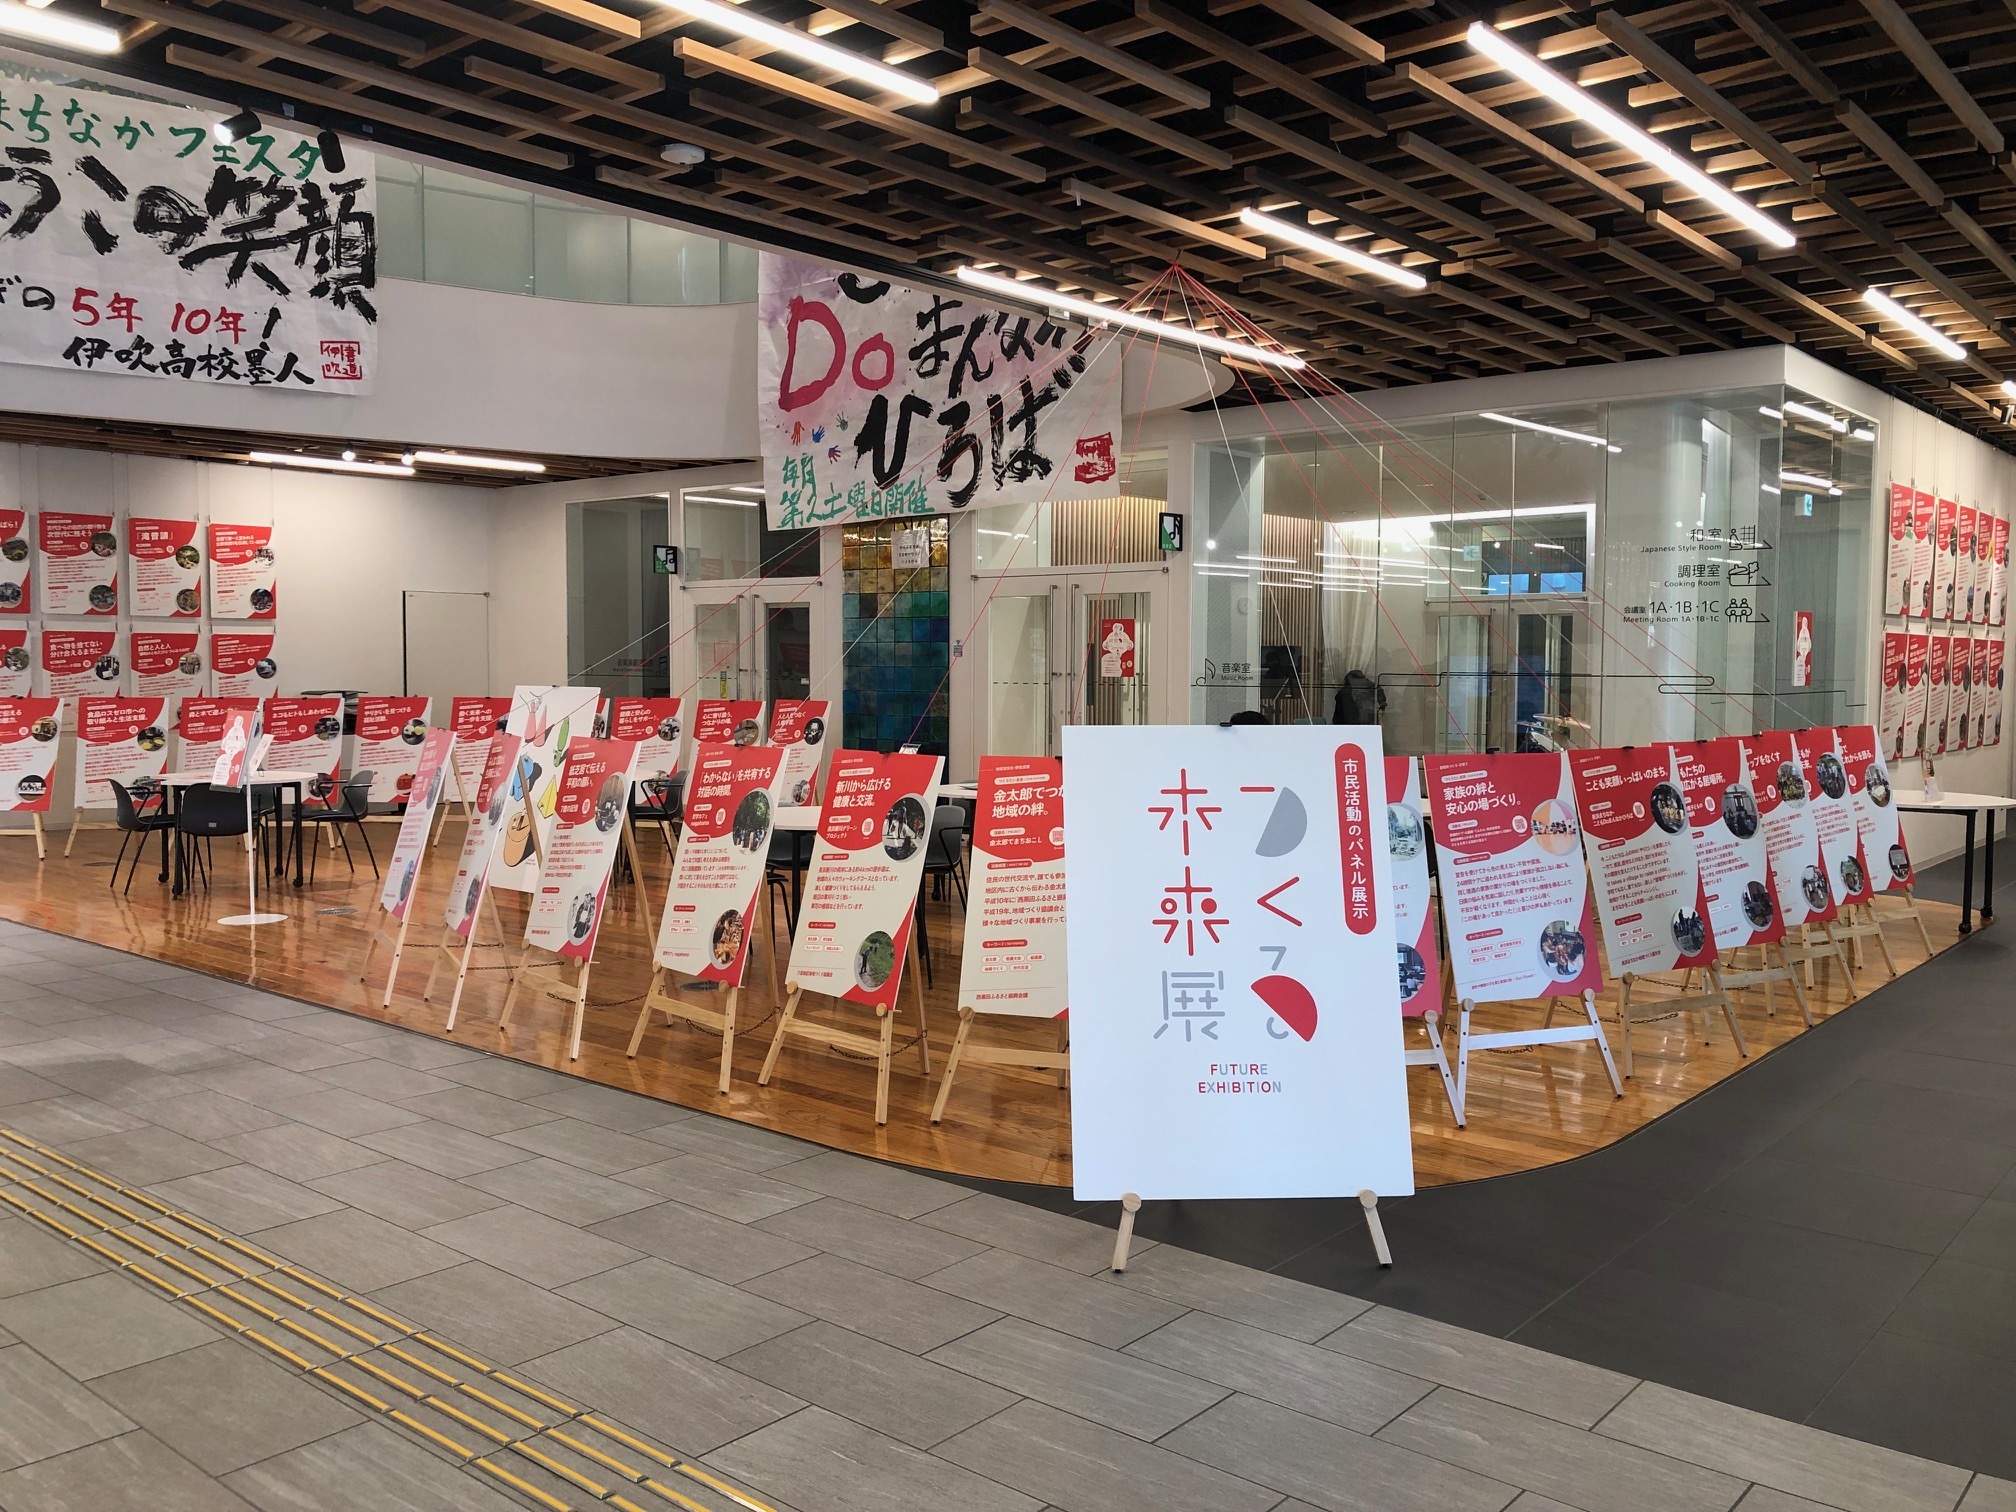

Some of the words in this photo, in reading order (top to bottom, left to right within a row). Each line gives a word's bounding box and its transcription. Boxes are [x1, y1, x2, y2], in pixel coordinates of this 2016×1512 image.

[71, 286, 144, 333] 5年
[62, 334, 316, 386] 伊吹高校墨人
[853, 355, 1087, 510] ひろば
[782, 453, 817, 488] 毎月
[1640, 545, 1676, 554] Japanese
[1678, 544, 1697, 552] Style
[1699, 543, 1722, 551] Room
[1677, 564, 1721, 578] 調理室
[1664, 580, 1696, 589] Cooking
[1623, 605, 1646, 614] 会議室
[1623, 615, 1655, 624] Meeting
[1656, 615, 1679, 623] Room
[1221, 662, 1251, 674] 音楽室
[87, 707, 146, 719] 食品ロスゼロ市への
[1747, 751, 1781, 768] ップをなくす
[1841, 750, 1874, 765] れからを語る。
[568, 762, 607, 776] 紙芝居で伝える
[700, 767, 772, 784] 「わからない」を共有する
[834, 777, 891, 794] 新川から広げる
[1585, 765, 1668, 792] こども笑顔いっぱいのまち。
[1680, 772, 1726, 791] 広がる居場所。
[1443, 781, 1496, 801] 家族の絆と
[832, 794, 875, 809] 健康と交流。
[1445, 792, 1521, 817] 安心の場づくり。
[991, 801, 1049, 819] 地域の絆。
[825, 832, 848, 840] プロジェクト
[989, 836, 1043, 847] 金太郎でまちおこし
[1341, 757, 1370, 920] 市民活動のパネル展示
[1147, 768, 1231, 1042] 未来展
[982, 916, 1067, 927] 様々な地域づくり事業を行って
[1209, 1063, 1269, 1077] FUTURE
[1197, 1080, 1283, 1095] EXHIBITION
